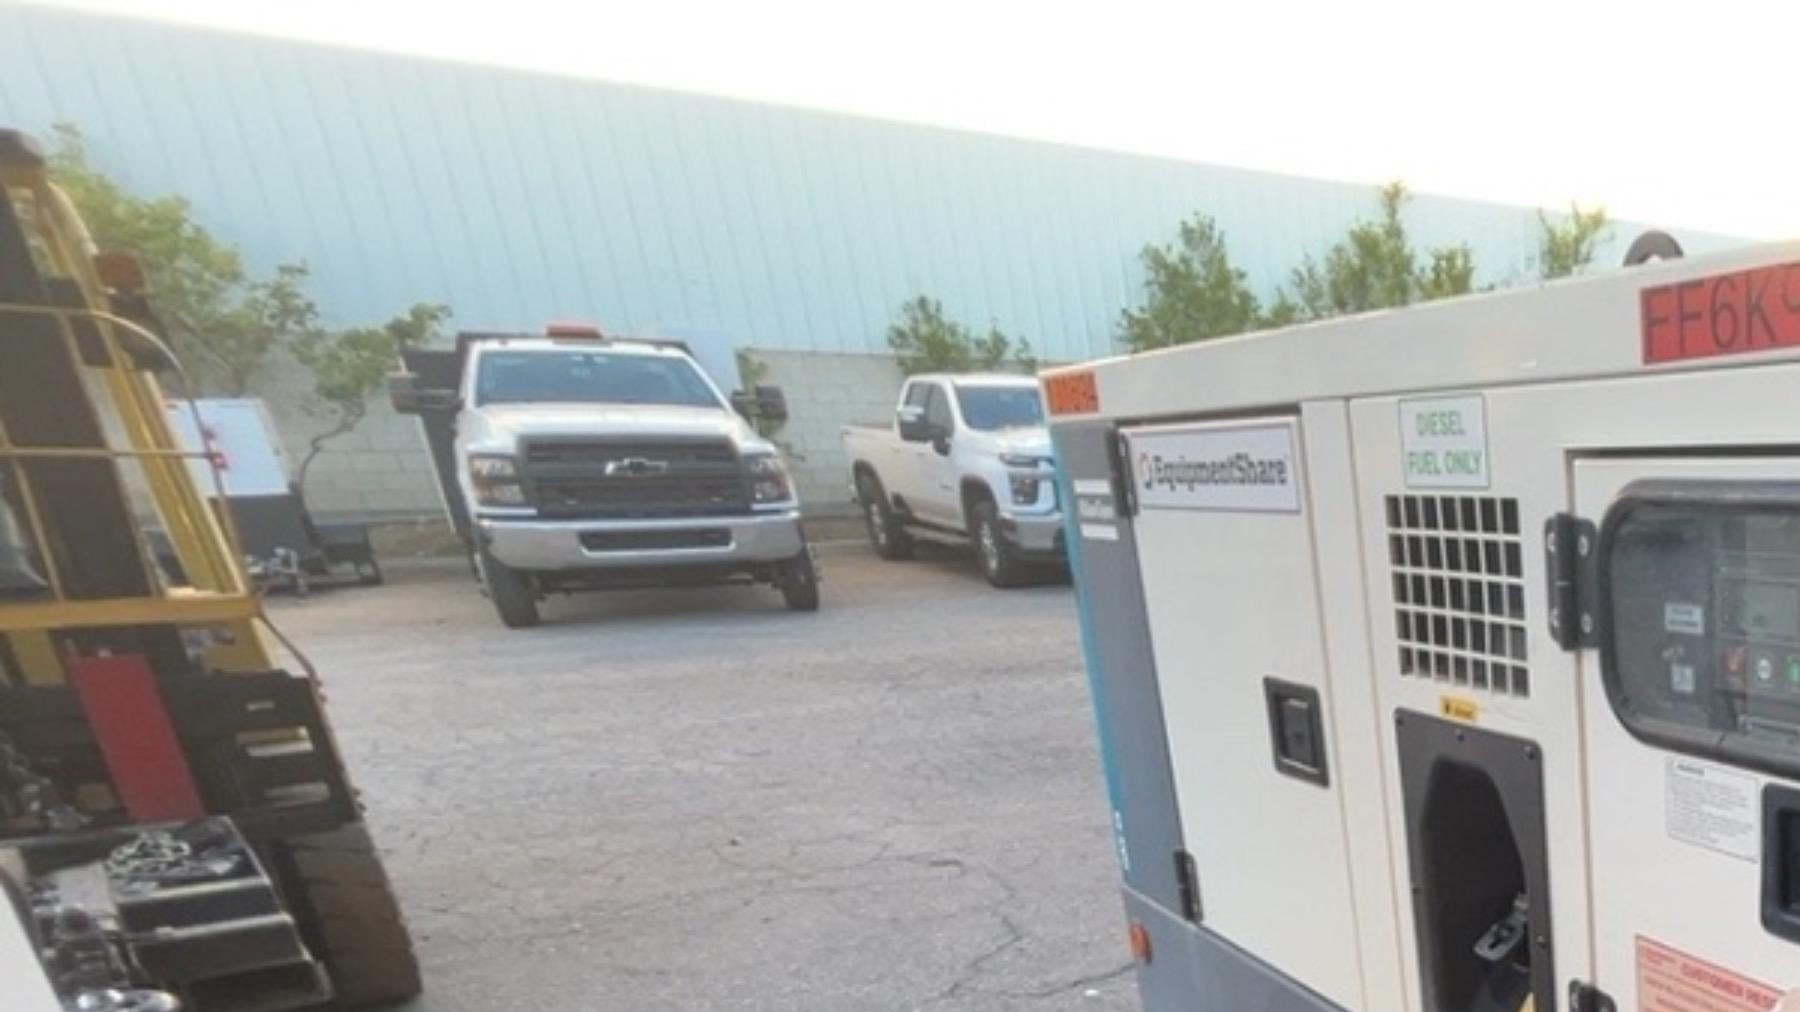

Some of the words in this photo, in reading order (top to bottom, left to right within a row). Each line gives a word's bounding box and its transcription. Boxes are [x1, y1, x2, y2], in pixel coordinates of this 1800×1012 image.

[1416, 410, 1466, 437] DIESEL
[1153, 452, 1289, 493] EquipmentShare
[1408, 449, 1442, 475] FUEL
[1444, 447, 1482, 475] ONLY
